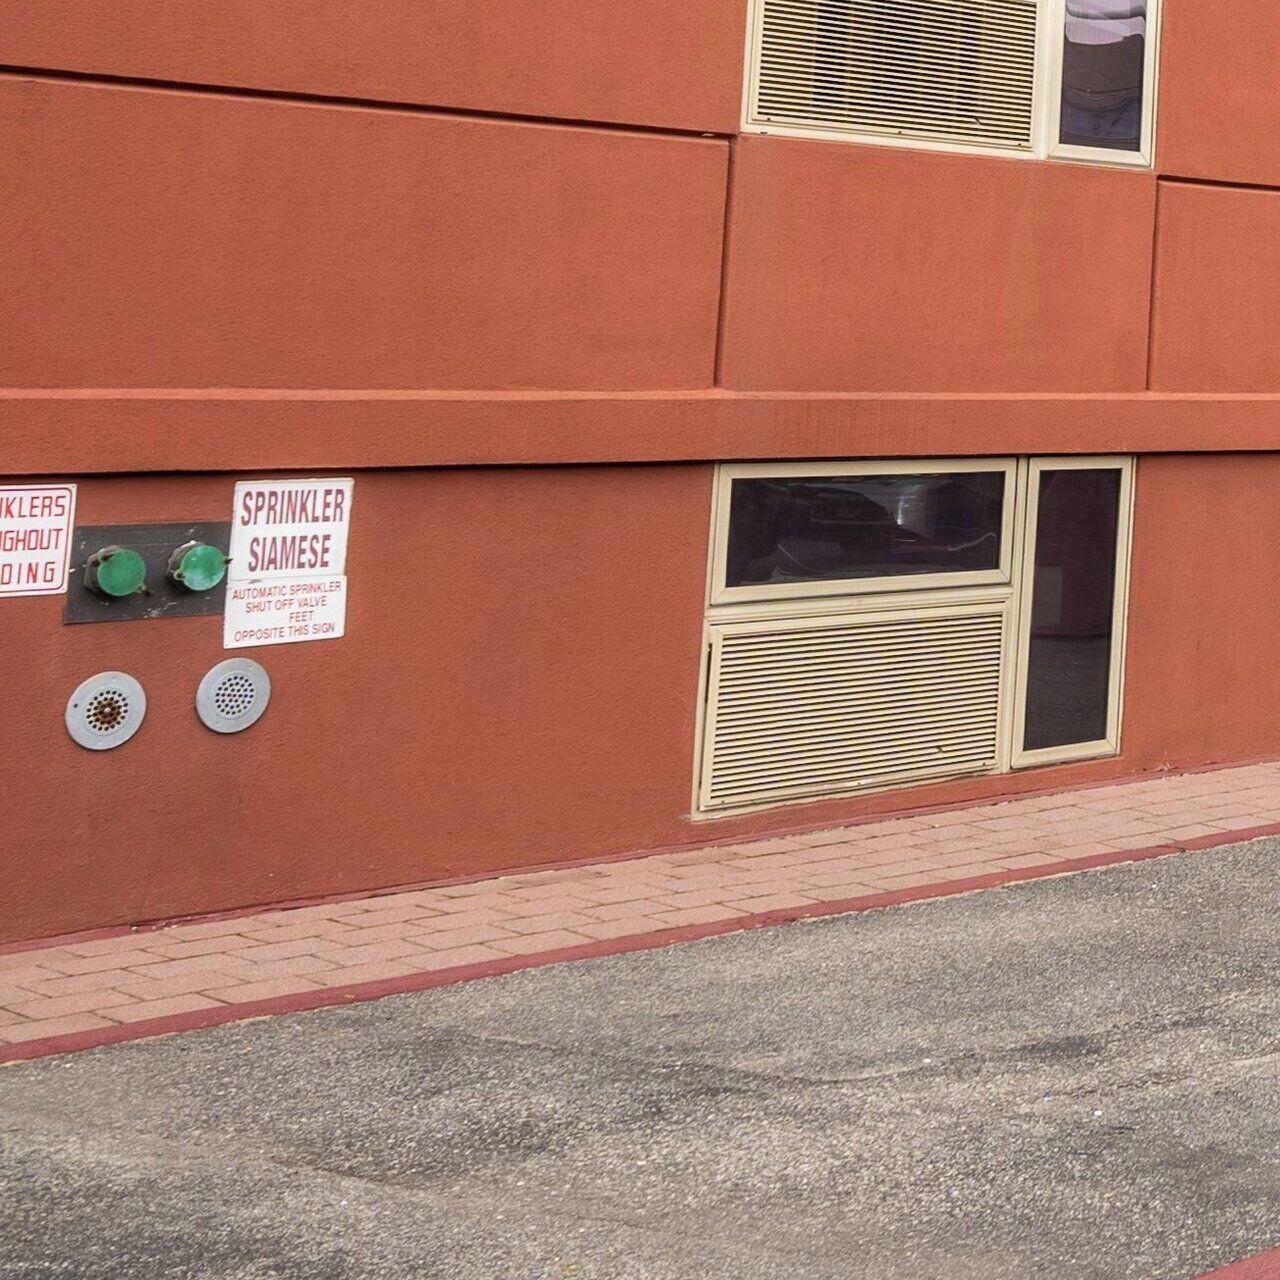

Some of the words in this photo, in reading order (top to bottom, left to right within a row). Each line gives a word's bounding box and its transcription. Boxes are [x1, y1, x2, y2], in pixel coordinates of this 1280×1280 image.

[240, 488, 345, 527] SPRINKLER
[0, 528, 64, 552] GHOUT
[248, 534, 331, 573] SIAMESE
[232, 585, 288, 600] AUTOMATIC
[290, 581, 342, 596] SPRINKLER
[245, 600, 273, 613] SHUT
[274, 598, 295, 611] OFF
[297, 595, 328, 608] VALVE
[289, 610, 315, 623] FEET
[234, 626, 286, 642] OPPOSITE
[288, 623, 309, 638] THIS
[311, 622, 336, 635] SIGN
